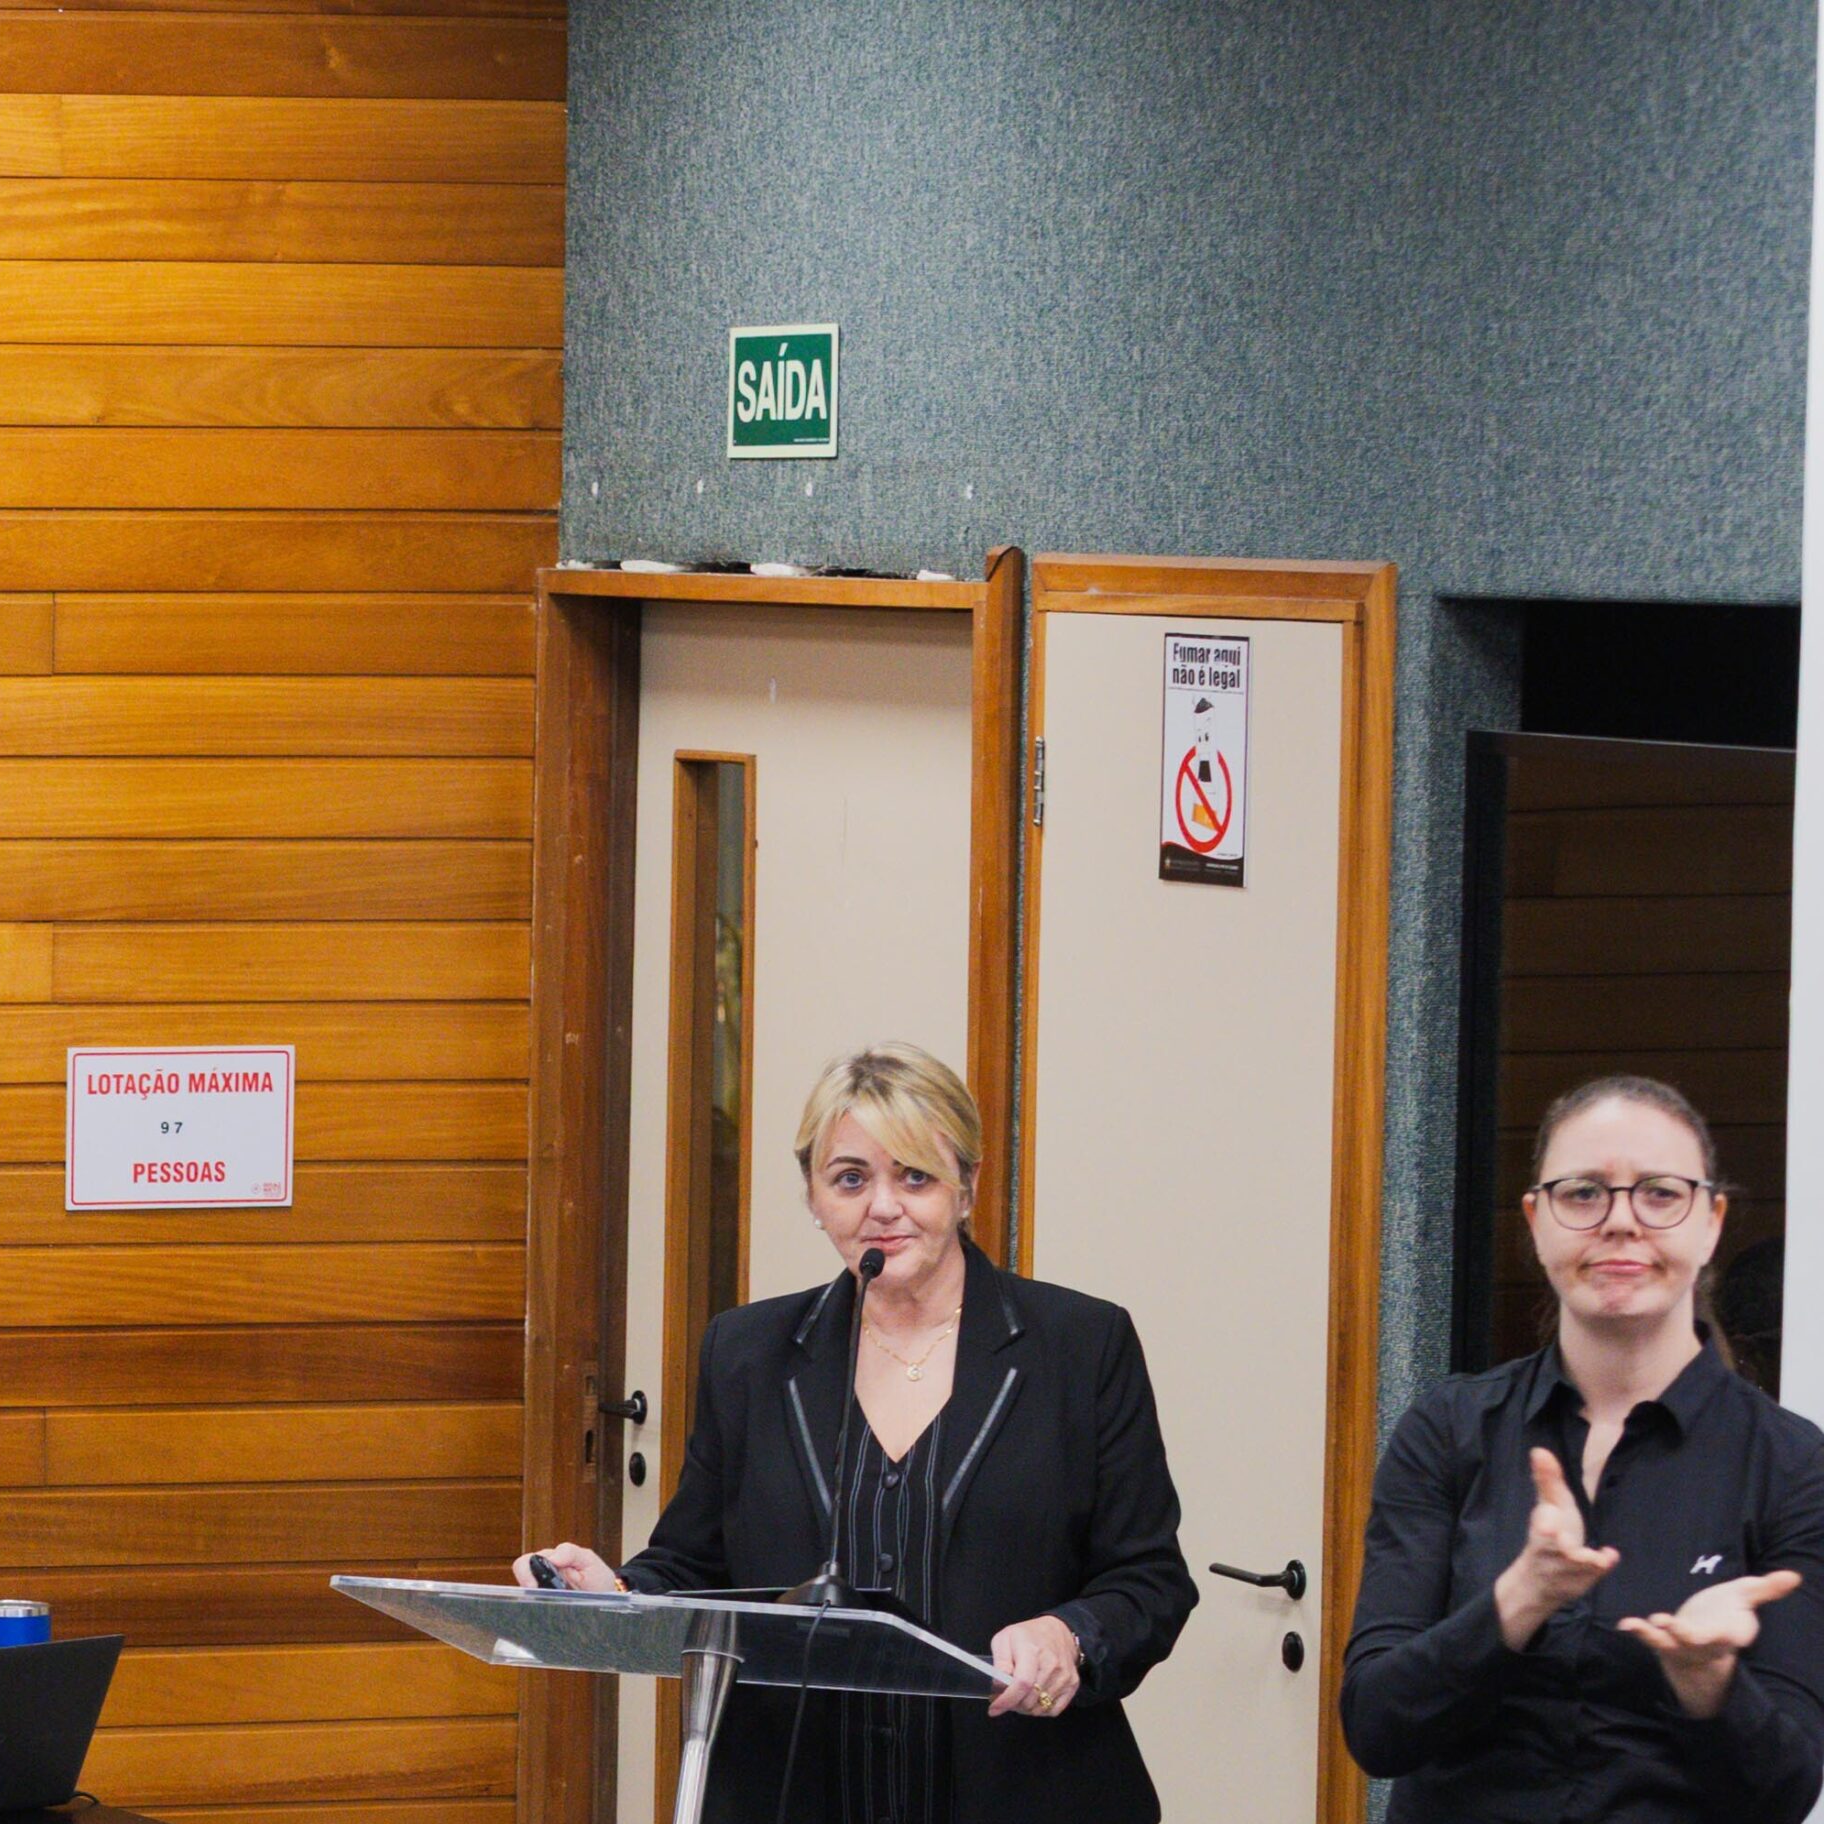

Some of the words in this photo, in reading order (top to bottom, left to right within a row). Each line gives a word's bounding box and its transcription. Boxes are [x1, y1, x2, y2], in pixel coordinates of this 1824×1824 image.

[737, 342, 827, 423] SAÍDA
[1173, 643, 1211, 663] Fumar
[1214, 646, 1241, 666] aqui
[1173, 664, 1195, 685] não
[1199, 665, 1205, 686] é
[1209, 667, 1240, 690] legal
[87, 1068, 180, 1101] LOTAÇÃO
[188, 1068, 274, 1093] MÁXIMA
[133, 1161, 226, 1184] PESSOAS
